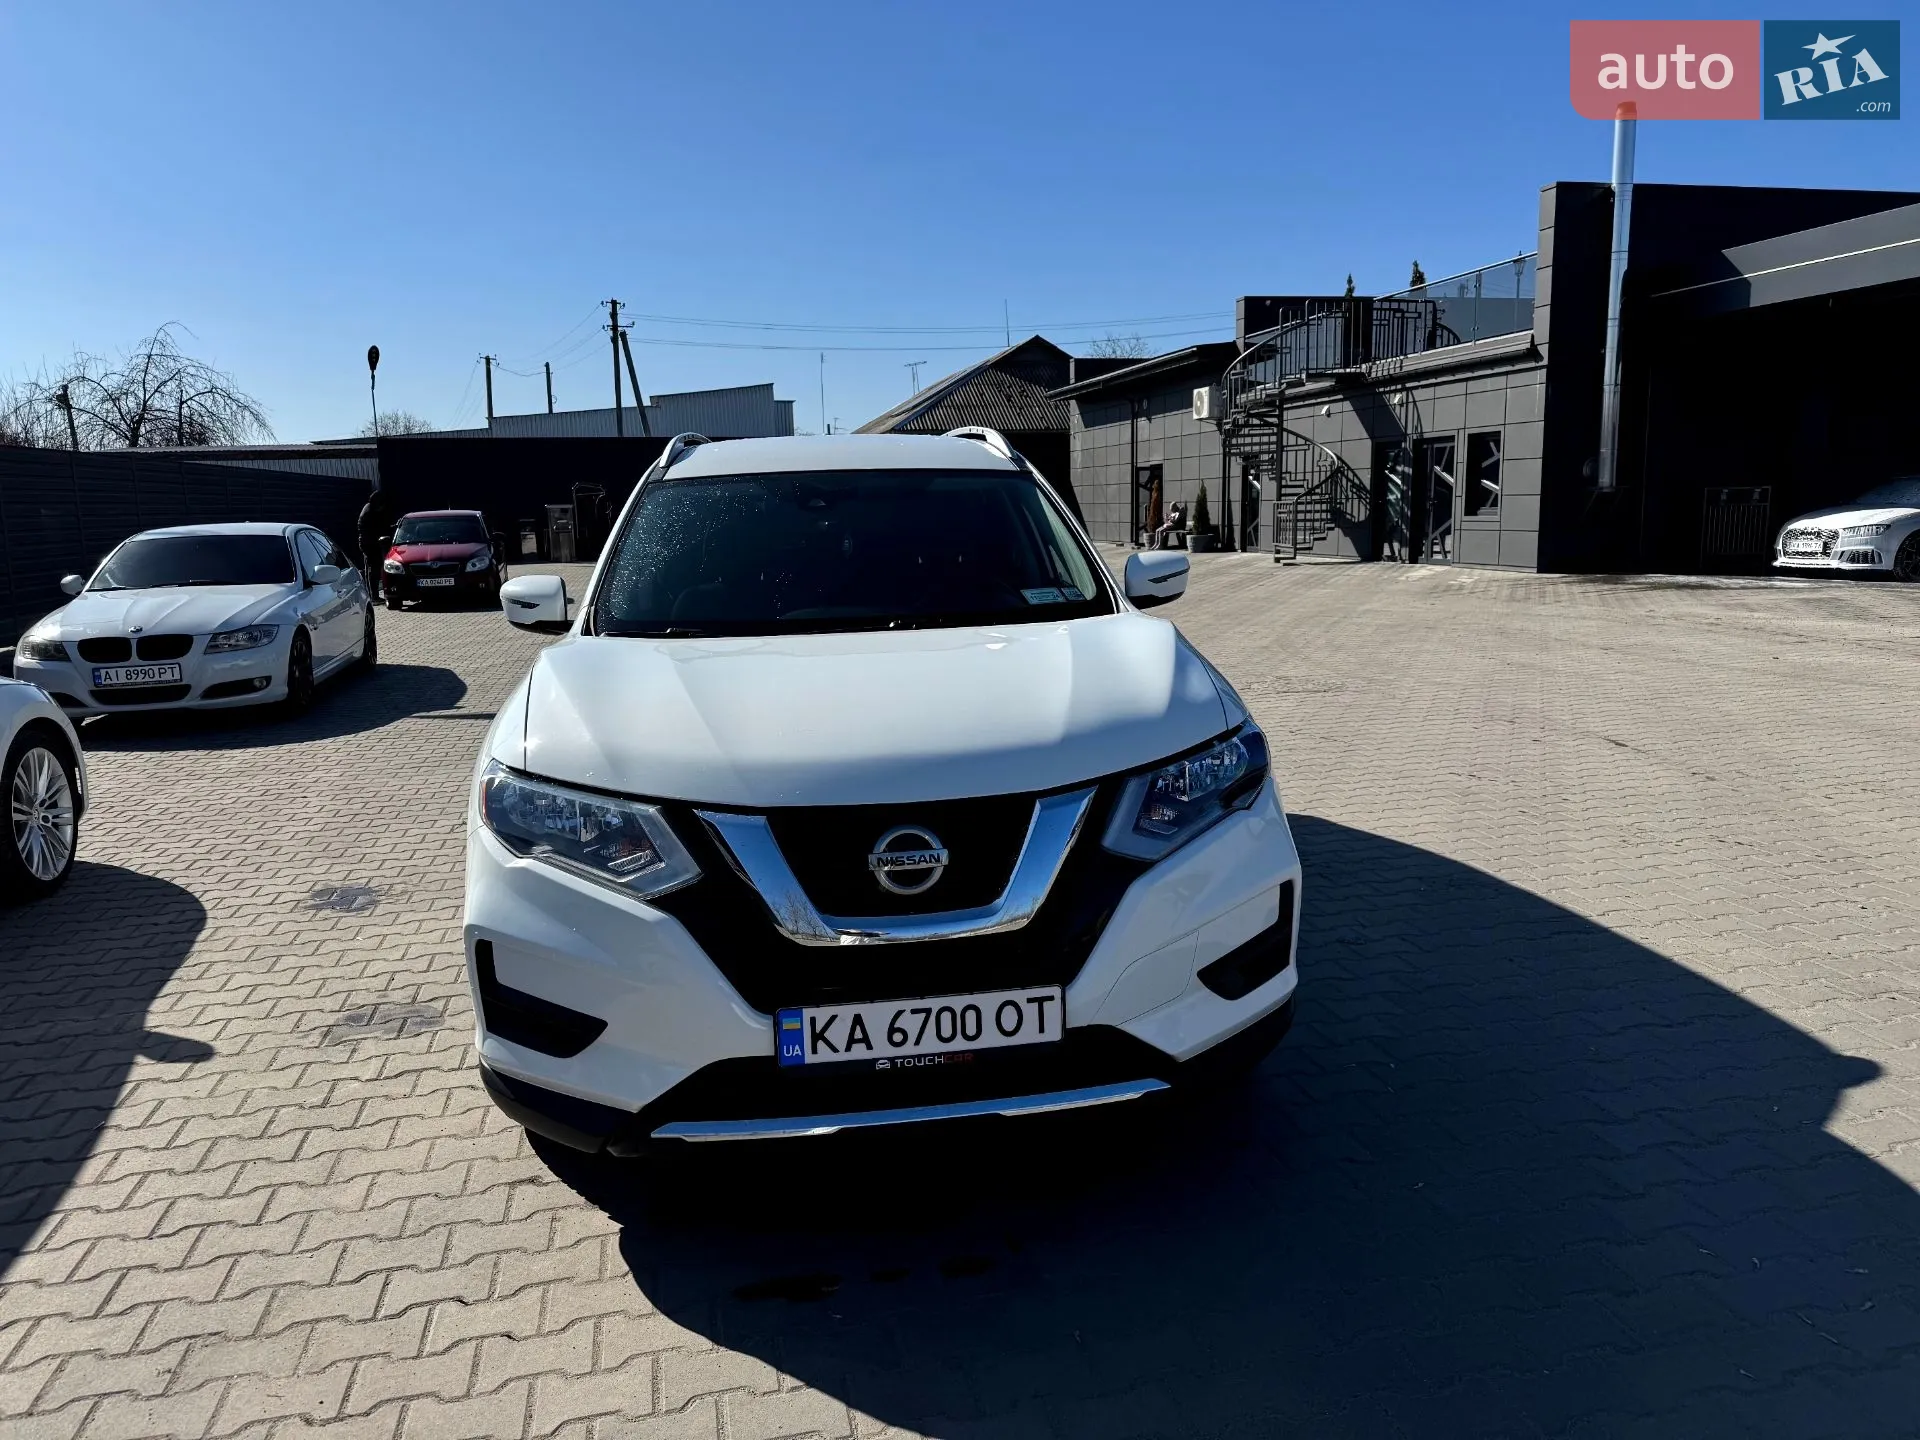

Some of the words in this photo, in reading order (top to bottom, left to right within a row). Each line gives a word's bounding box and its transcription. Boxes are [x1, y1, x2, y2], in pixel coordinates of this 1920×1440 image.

[103, 669, 120, 682] AI
[125, 667, 155, 681] 8990
[158, 666, 177, 679] PT
[876, 852, 941, 868] NISSAN
[809, 1013, 874, 1055] KA
[886, 1003, 983, 1048] 6700
[995, 995, 1055, 1038] OT
[783, 1045, 802, 1058] UA
